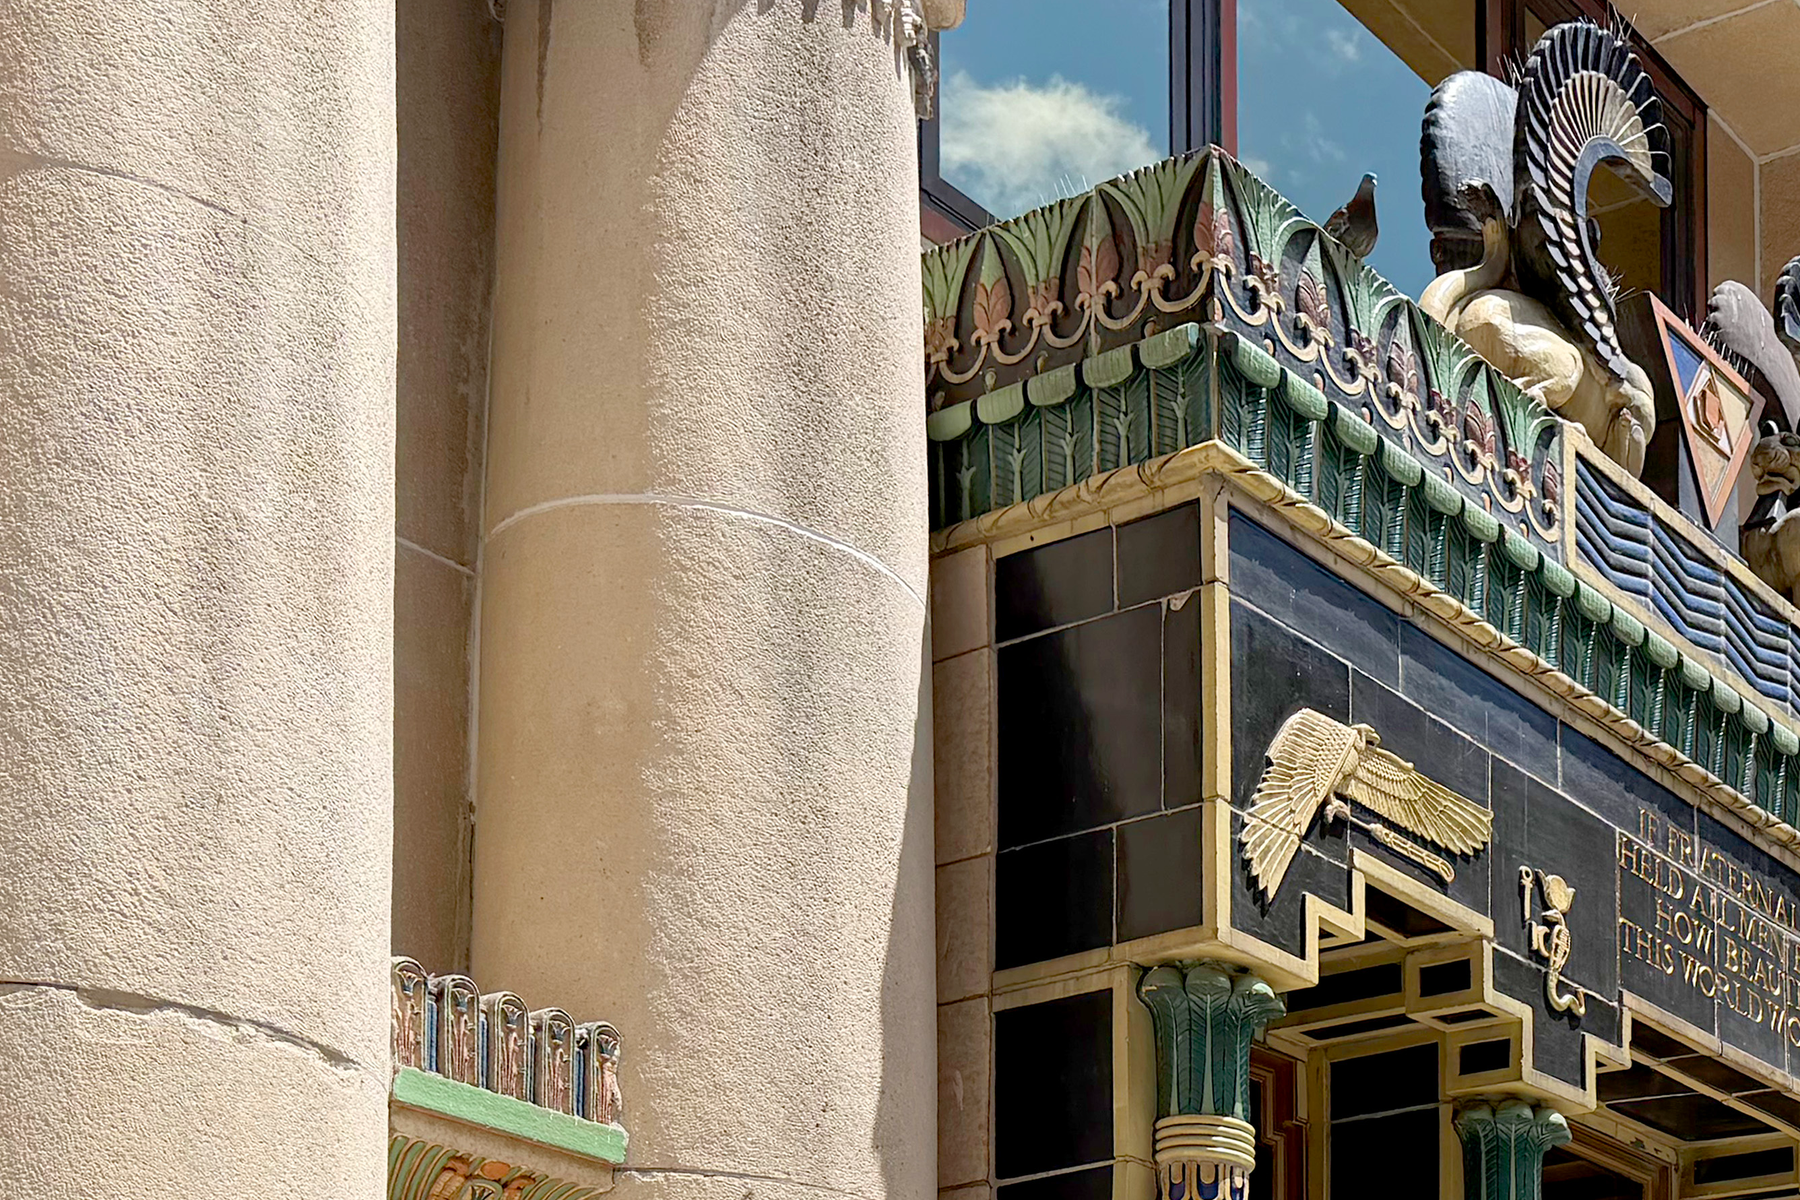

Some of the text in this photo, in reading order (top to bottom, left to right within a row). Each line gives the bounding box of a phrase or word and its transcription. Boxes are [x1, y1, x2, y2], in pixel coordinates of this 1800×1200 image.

[1638, 806, 1660, 848] IF
[1619, 836, 1683, 900] HELD
[1690, 885, 1735, 932] ALL
[1739, 913, 1789, 967] MEN
[1655, 898, 1714, 955] HOW
[1619, 917, 1674, 975] THIS
[1678, 950, 1764, 1024] WORLD
